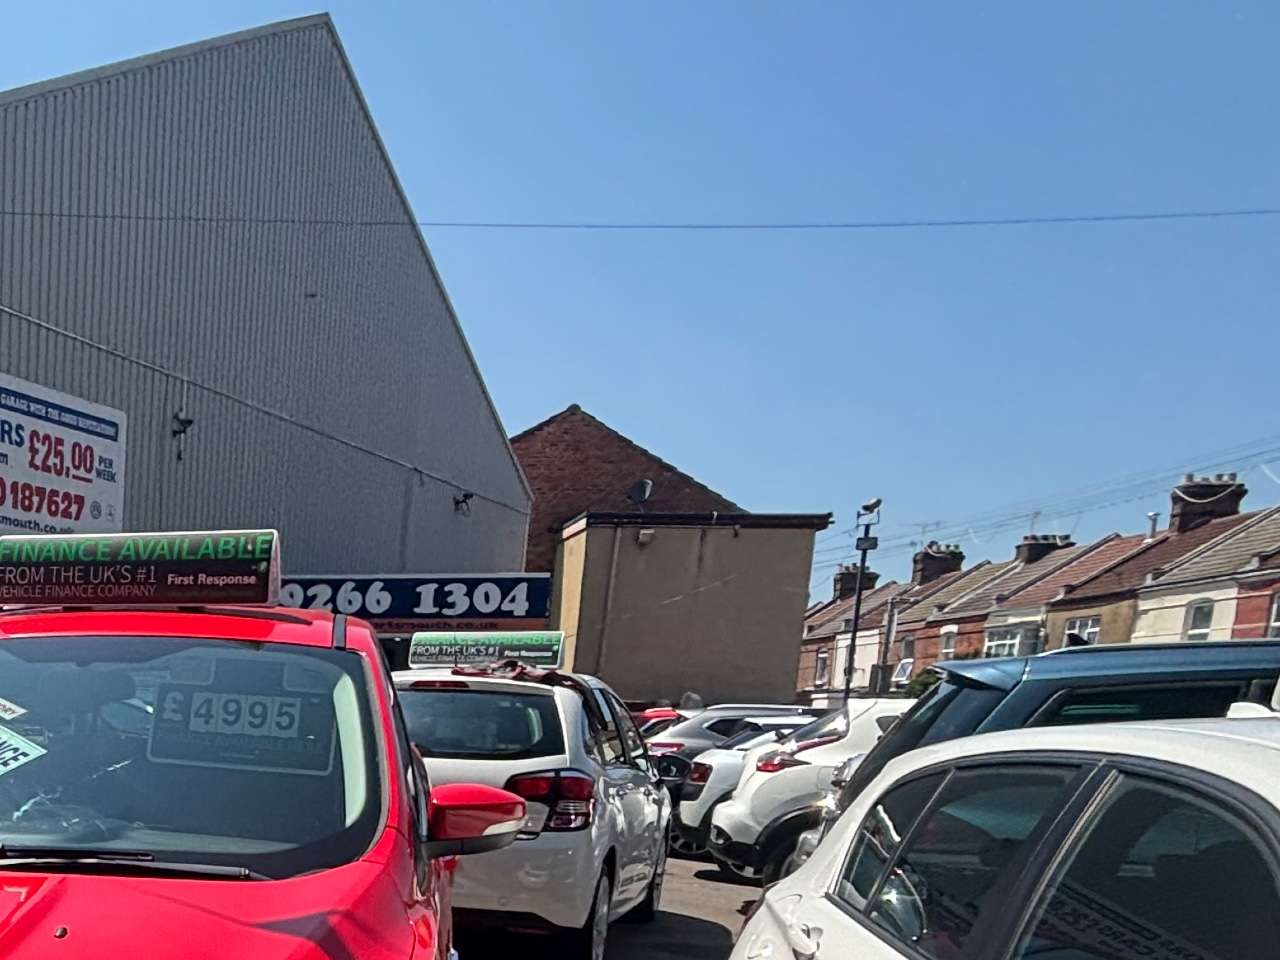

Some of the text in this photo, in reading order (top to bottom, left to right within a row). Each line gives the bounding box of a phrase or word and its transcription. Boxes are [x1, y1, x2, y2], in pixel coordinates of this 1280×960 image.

[98, 456, 113, 469] PER
[96, 468, 116, 482] WEEK
[10, 481, 85, 521] 187627
[119, 535, 272, 561] AVAILABLE
[50, 566, 84, 584] THE
[90, 565, 131, 583] UK'S
[135, 565, 157, 583] #1
[167, 573, 257, 587] First Response
[45, 585, 96, 598] FINANCE
[97, 584, 157, 598] COMPANY
[413, 581, 529, 616] 1304
[411, 646, 439, 656] FROM
[440, 646, 461, 656] THE
[162, 692, 297, 731] £4995
